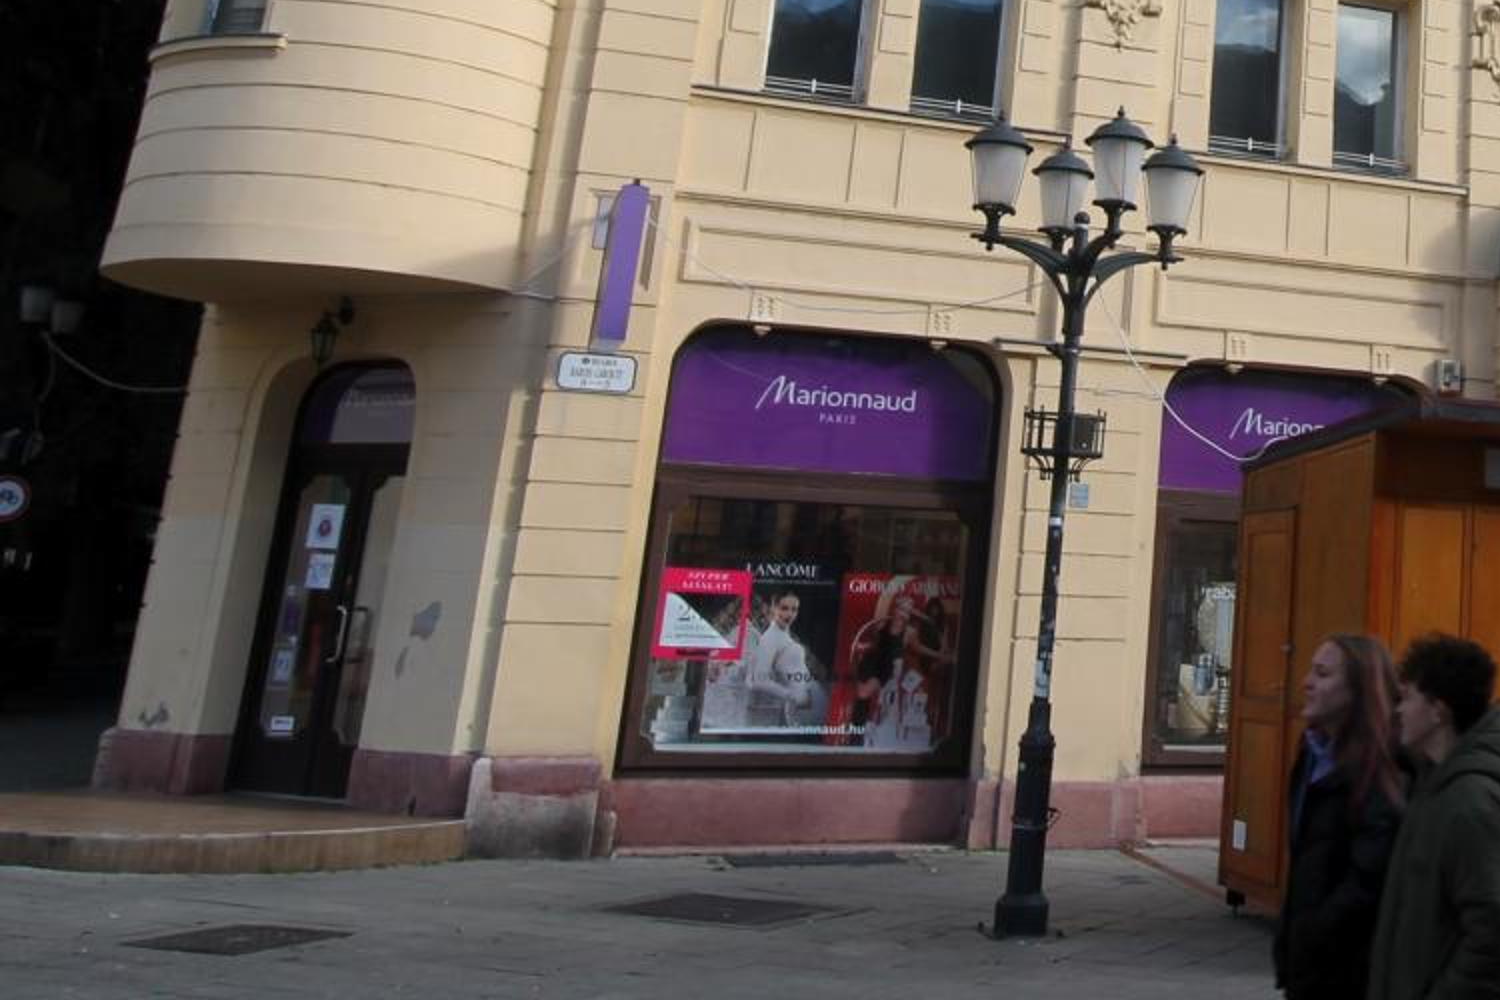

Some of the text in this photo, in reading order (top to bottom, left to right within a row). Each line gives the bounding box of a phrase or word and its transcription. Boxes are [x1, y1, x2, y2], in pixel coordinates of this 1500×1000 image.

[755, 375, 917, 412] Marionnaud
[819, 413, 857, 425] PARIS
[1229, 407, 1314, 439] Marion
